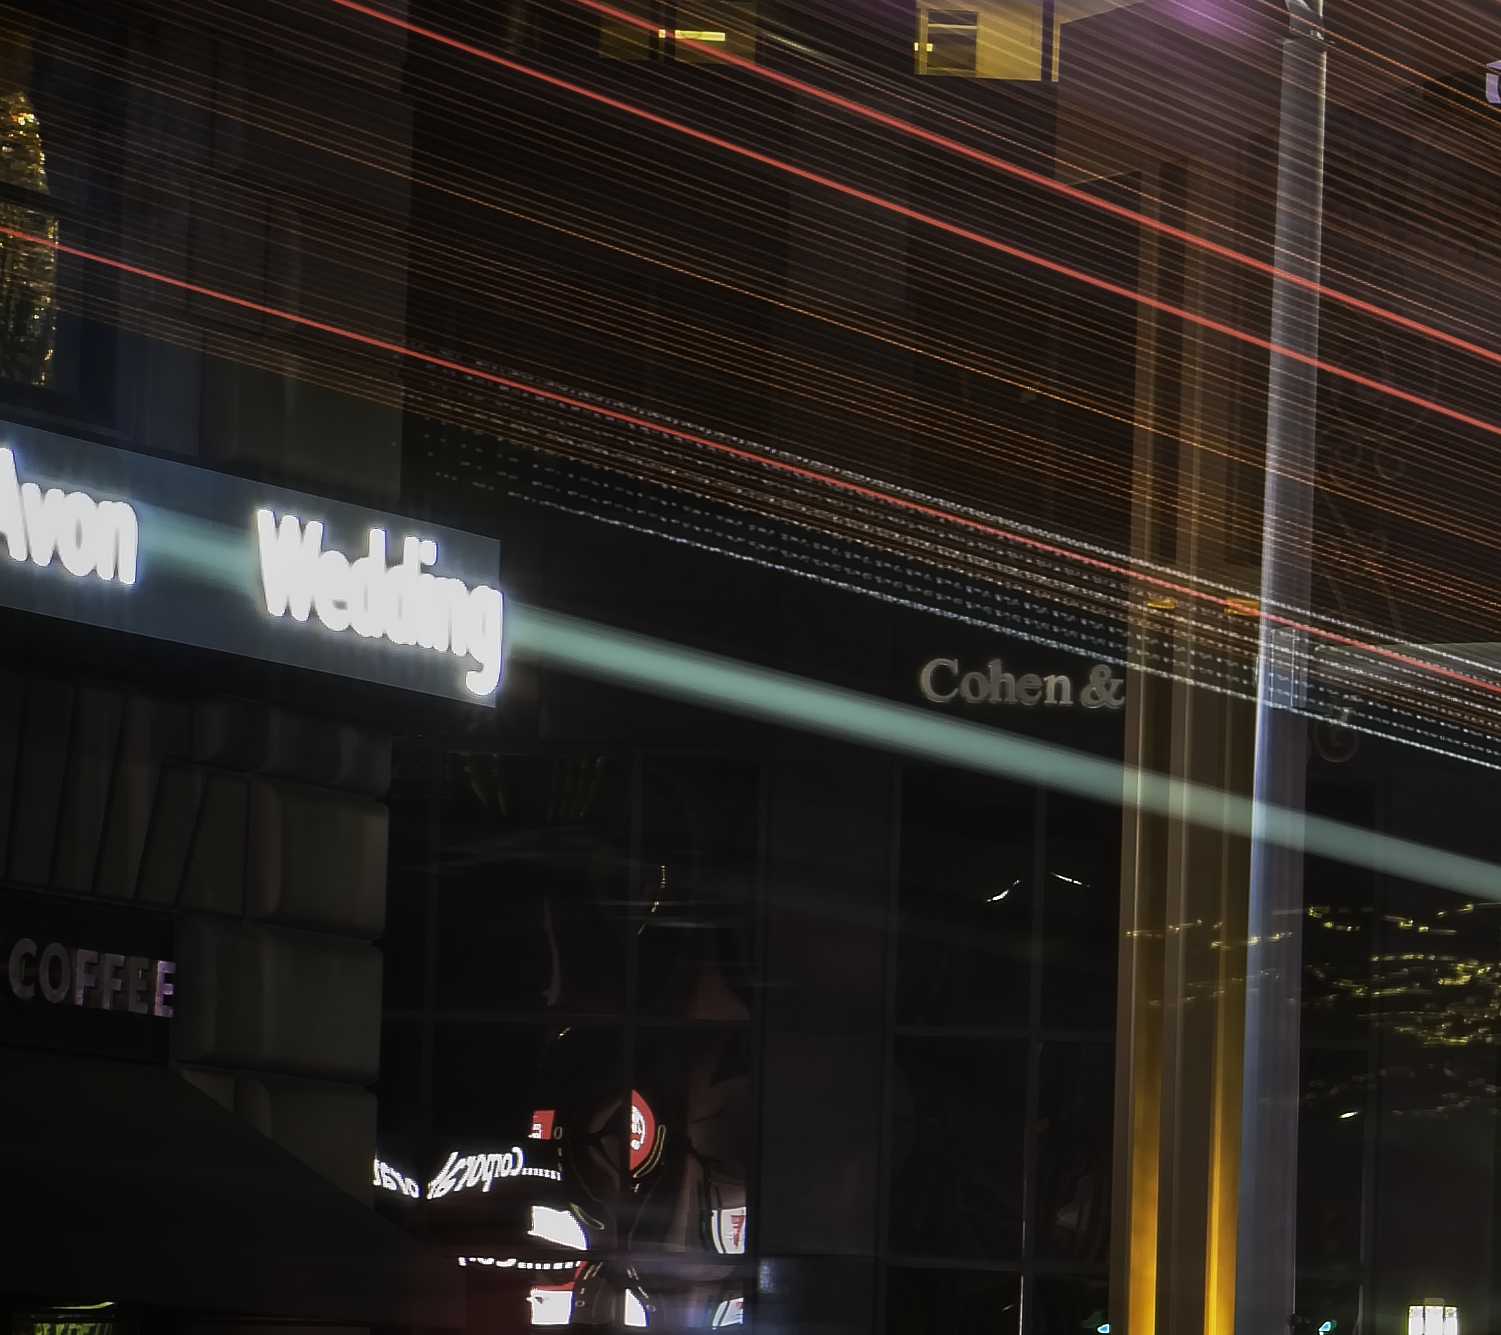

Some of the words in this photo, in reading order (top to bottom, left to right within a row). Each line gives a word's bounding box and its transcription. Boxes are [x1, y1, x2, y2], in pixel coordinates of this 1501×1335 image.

[256, 509, 504, 696] Wedding
[919, 657, 1074, 706] Cohen
[1080, 663, 1126, 710] &
[8, 937, 178, 1019] COFFEE
